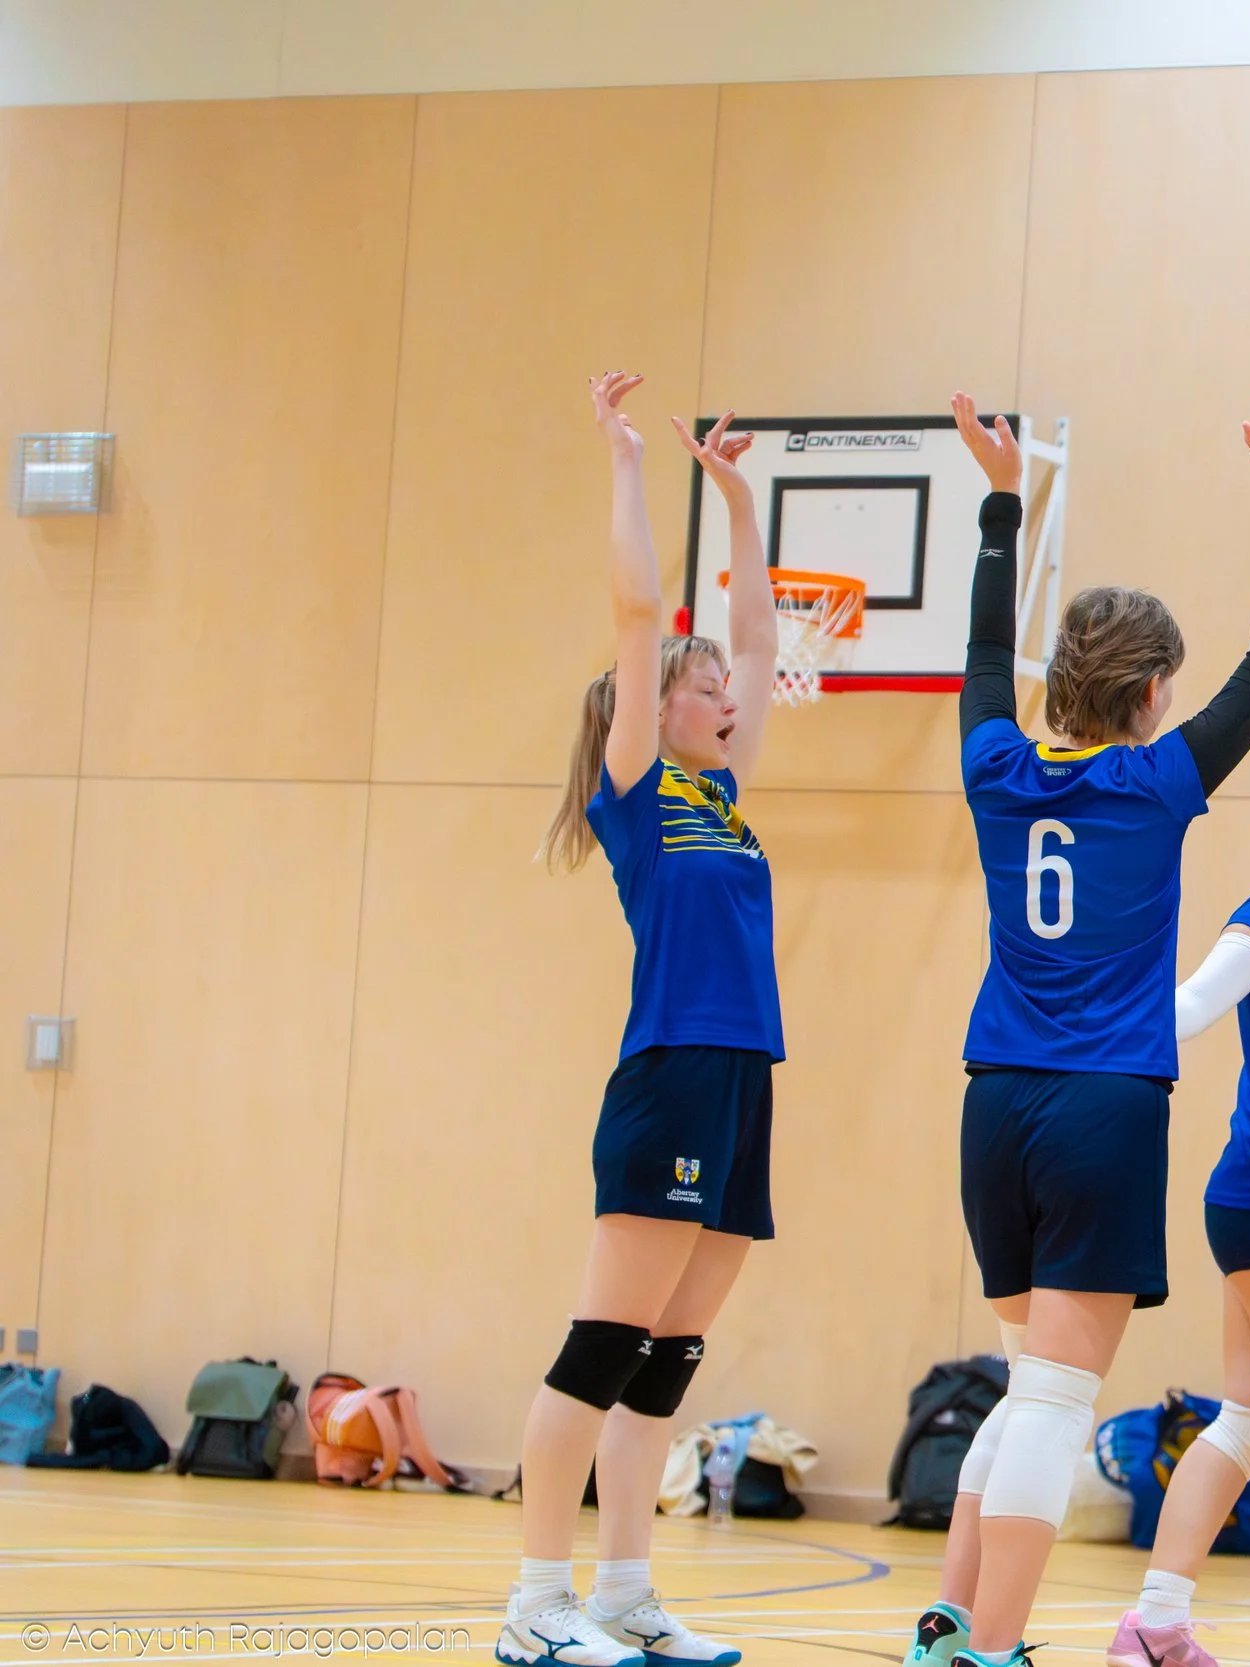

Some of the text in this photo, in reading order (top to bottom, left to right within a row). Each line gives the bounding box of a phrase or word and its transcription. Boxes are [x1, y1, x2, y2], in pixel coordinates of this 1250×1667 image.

[787, 434, 918, 449] CONTINENTAL
[1026, 819, 1074, 939] 6
[667, 1193, 703, 1204] University
[671, 1189, 699, 1198] Abertay
